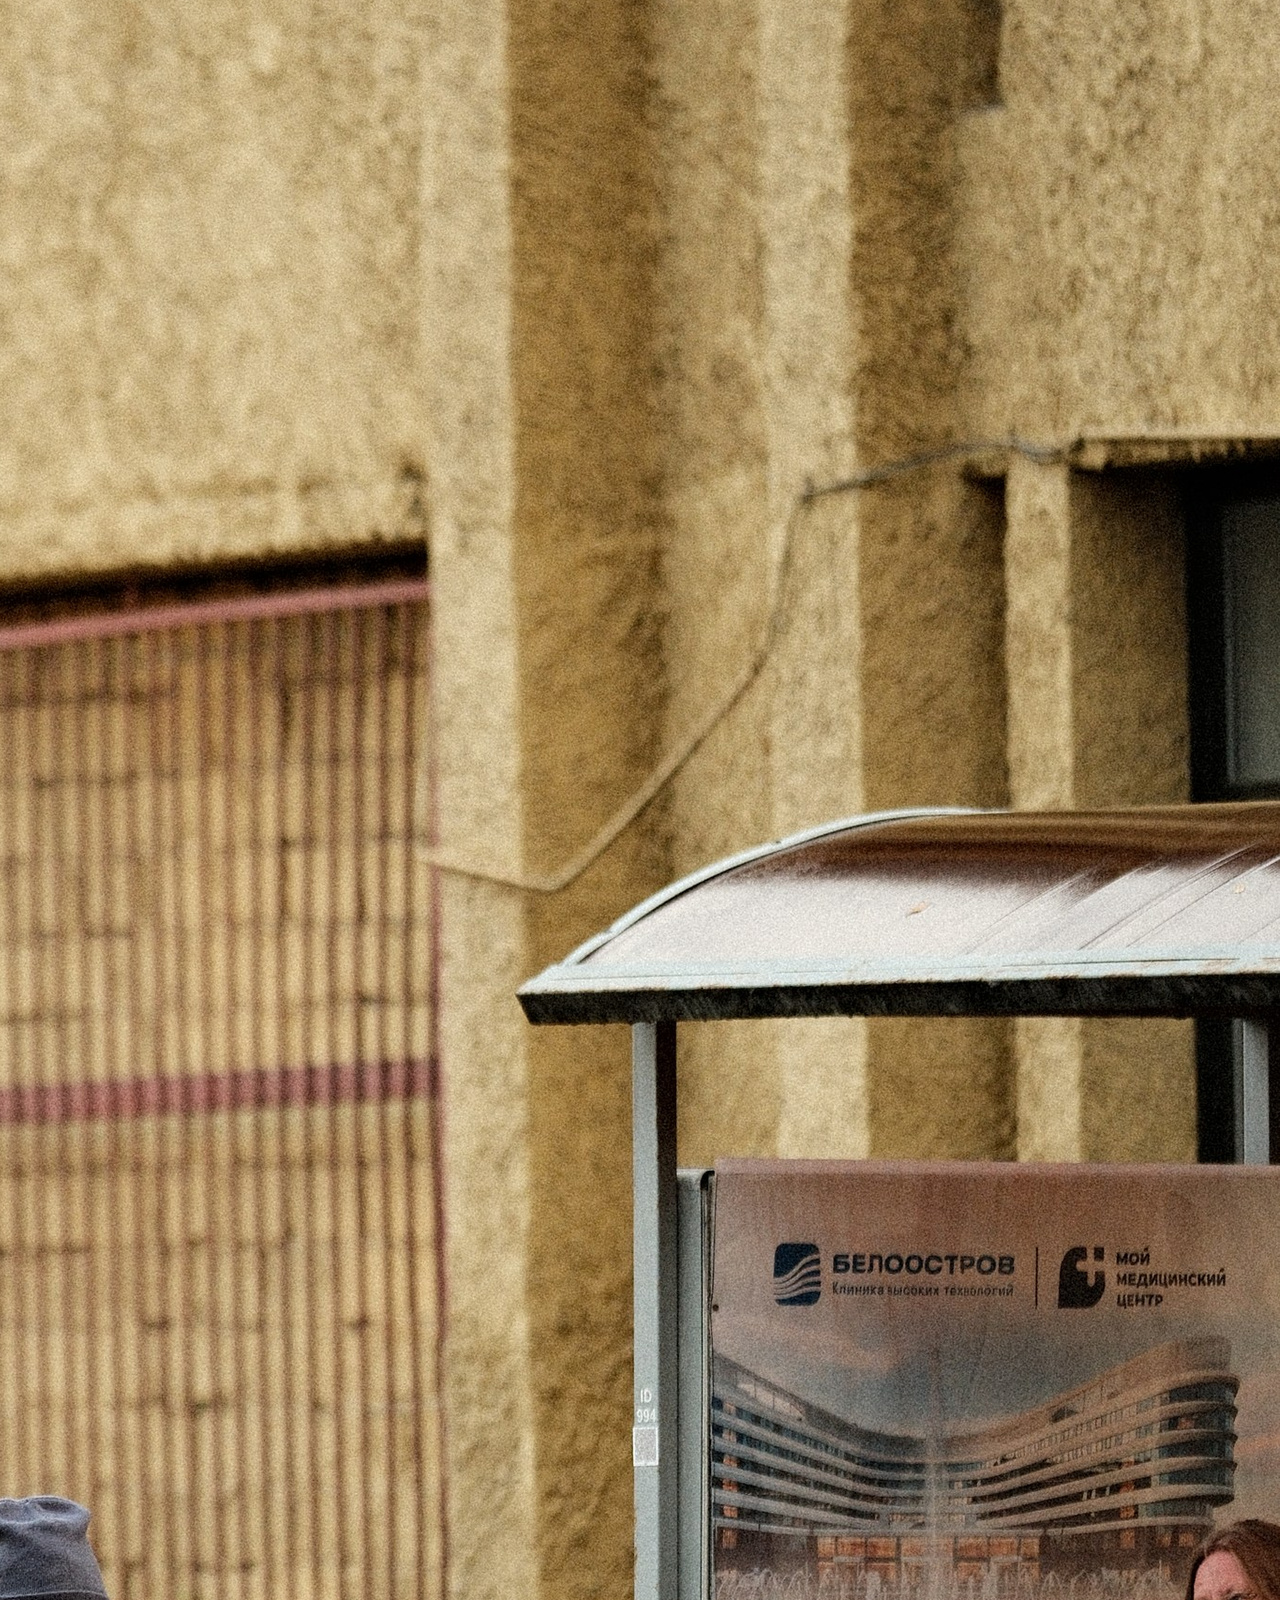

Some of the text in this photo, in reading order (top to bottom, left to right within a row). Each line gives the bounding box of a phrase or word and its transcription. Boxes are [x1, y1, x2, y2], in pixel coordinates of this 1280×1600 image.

[832, 1253, 1015, 1276] БЕЛООСТРОВ
[1115, 1246, 1151, 1266] МОЙ
[1116, 1267, 1227, 1289] МЕДИЦИНСКИЙ
[832, 1281, 1014, 1297] Клиника высоких технологий
[1116, 1293, 1164, 1309] ЦЕНТР
